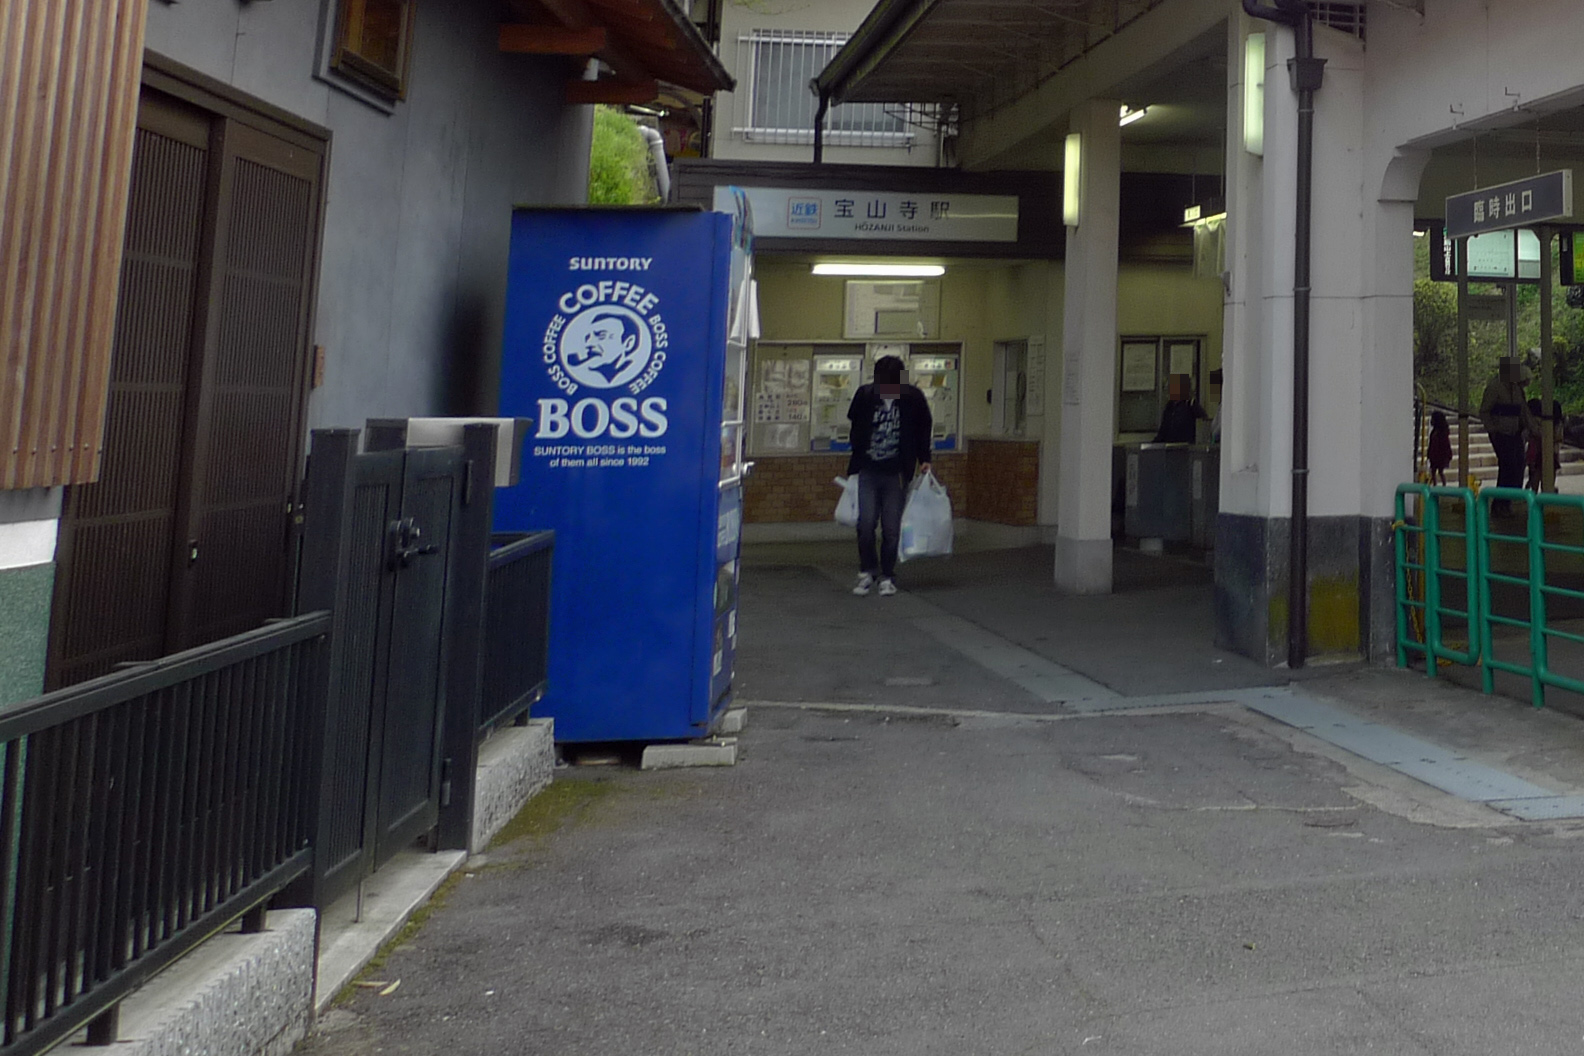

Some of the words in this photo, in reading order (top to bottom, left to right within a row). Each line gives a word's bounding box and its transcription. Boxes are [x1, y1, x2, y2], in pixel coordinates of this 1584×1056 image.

[834, 199, 950, 221] 宝山寺駅
[1473, 189, 1533, 224] 臨時出口
[897, 224, 930, 234] Station
[568, 257, 653, 271] SUNTORY
[559, 281, 660, 316] COFFEE
[543, 314, 566, 364] COFFEE
[648, 314, 668, 348] BOSS
[548, 364, 579, 395] BOSS
[629, 352, 667, 395] COFFEE
[535, 397, 668, 439] BOSS
[534, 446, 585, 456] SUNTORY
[587, 446, 616, 455] BOSS
[617, 446, 626, 455] is
[627, 446, 643, 455] the
[644, 446, 666, 455] boss
[550, 458, 559, 467] of
[561, 458, 585, 467] them
[587, 458, 598, 467] all
[600, 457, 625, 467] since
[627, 457, 649, 466] 1992
